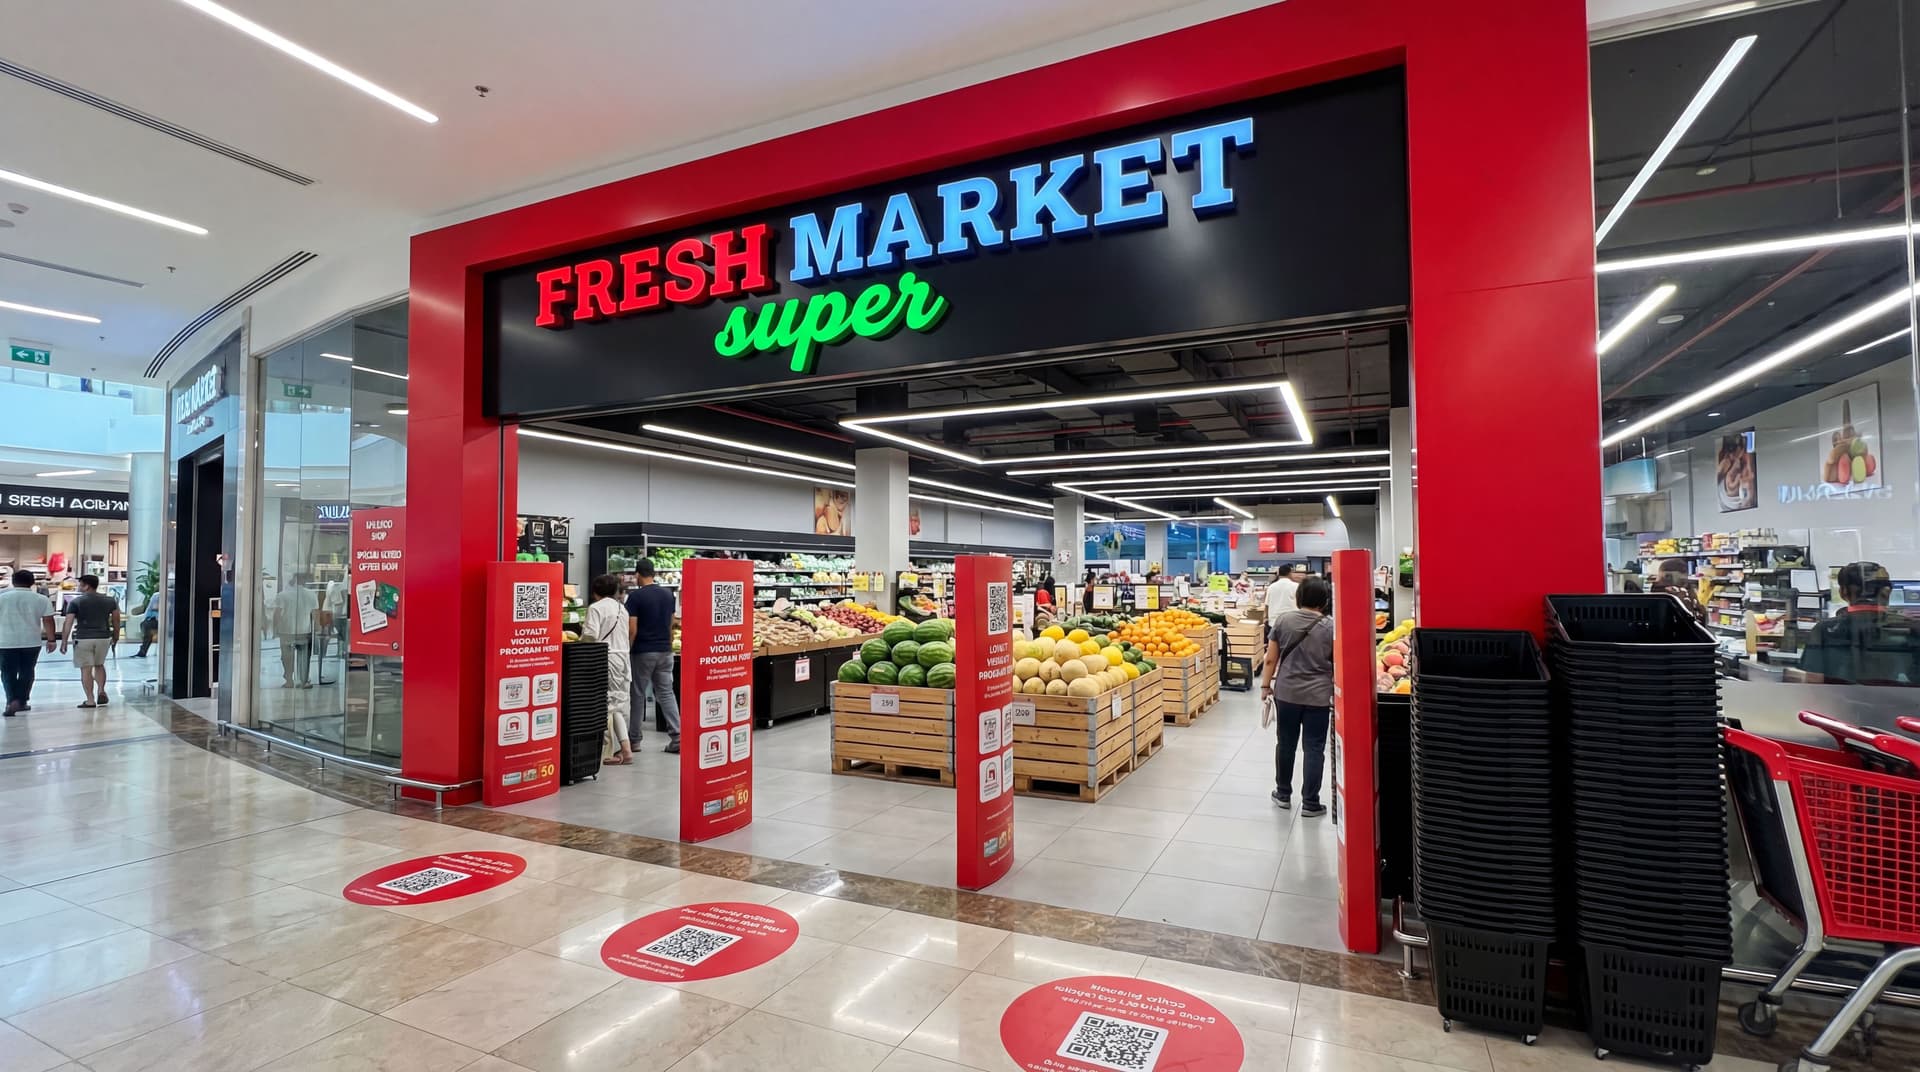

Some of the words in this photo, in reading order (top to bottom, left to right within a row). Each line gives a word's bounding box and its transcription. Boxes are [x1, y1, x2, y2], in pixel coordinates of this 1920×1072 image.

[535, 222, 770, 329] FRESH
[789, 116, 1255, 283] MARKET
[714, 271, 947, 373] super
[8, 494, 65, 509] SRESH
[514, 627, 548, 636] LOYALTY
[713, 633, 743, 643] LOYALTY
[541, 764, 555, 777] 50
[737, 789, 749, 804] 50
